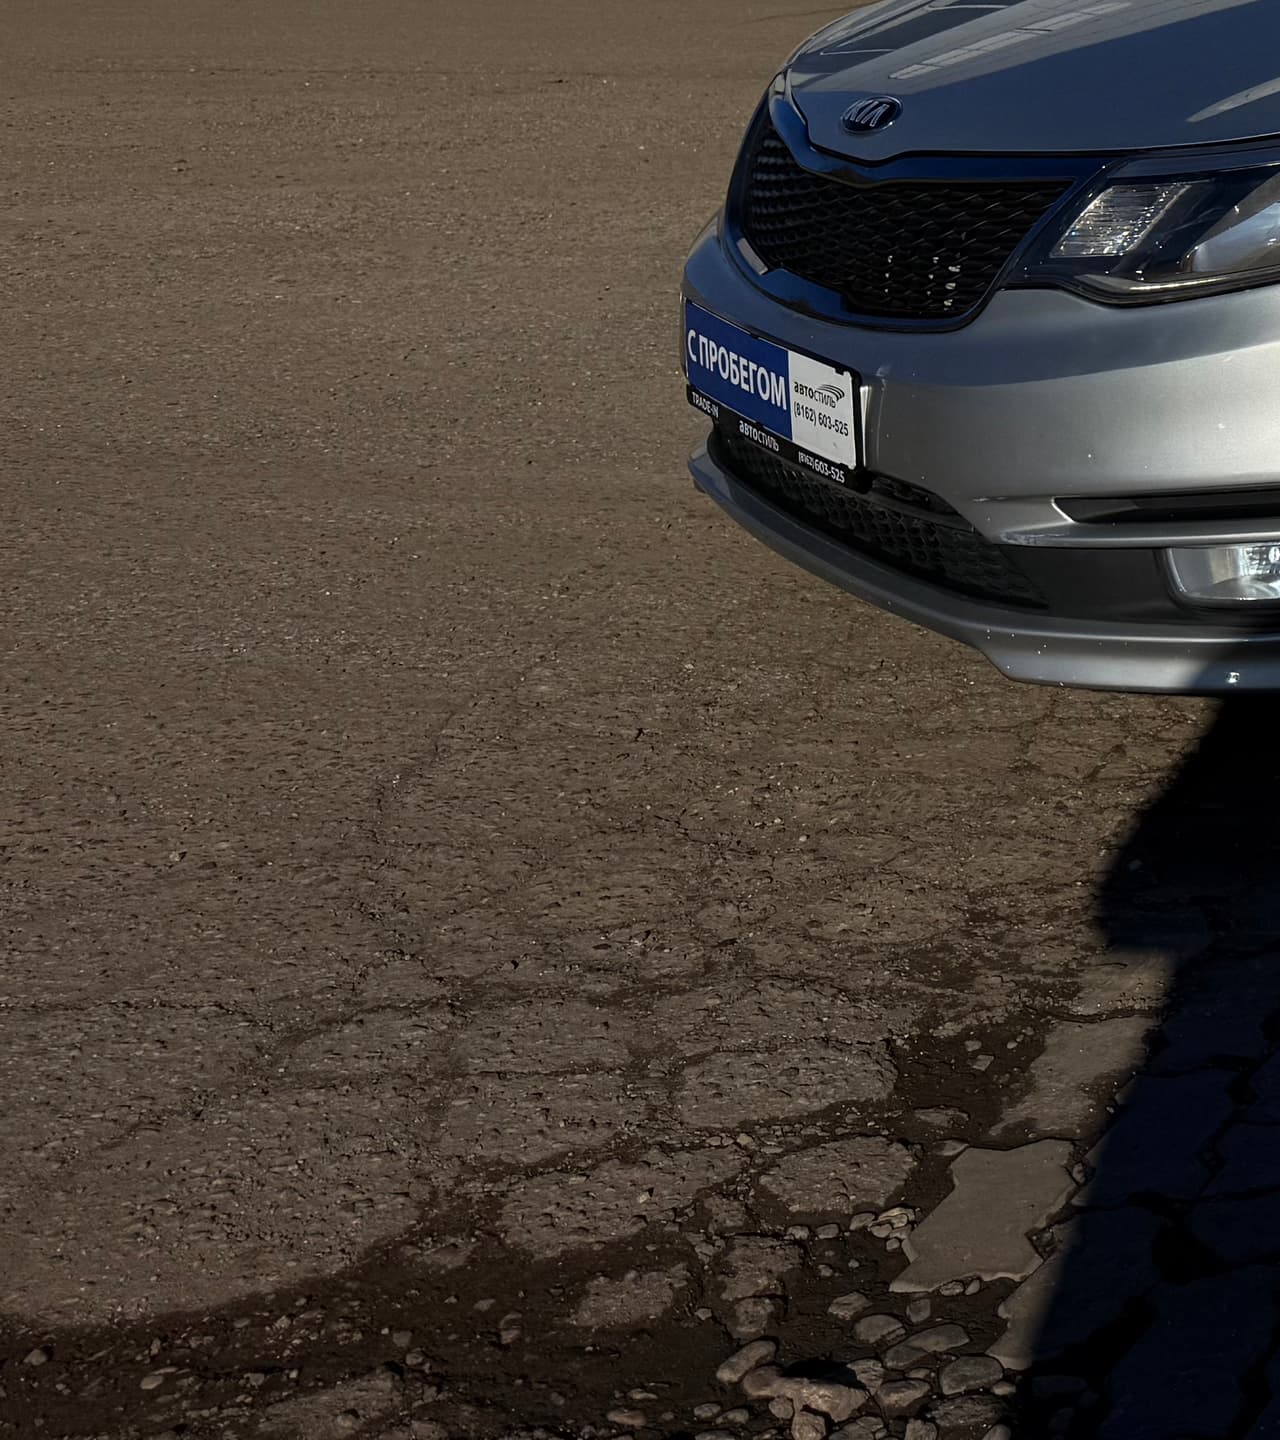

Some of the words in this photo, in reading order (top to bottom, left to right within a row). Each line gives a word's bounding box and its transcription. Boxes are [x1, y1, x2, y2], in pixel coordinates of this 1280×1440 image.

[687, 329, 697, 362] С
[699, 334, 787, 411] ПРОБЕГОМ
[692, 391, 719, 418] TRADE-IN
[793, 400, 817, 427] (8162)
[818, 412, 849, 437] 603-525
[814, 459, 846, 484] 603-525
